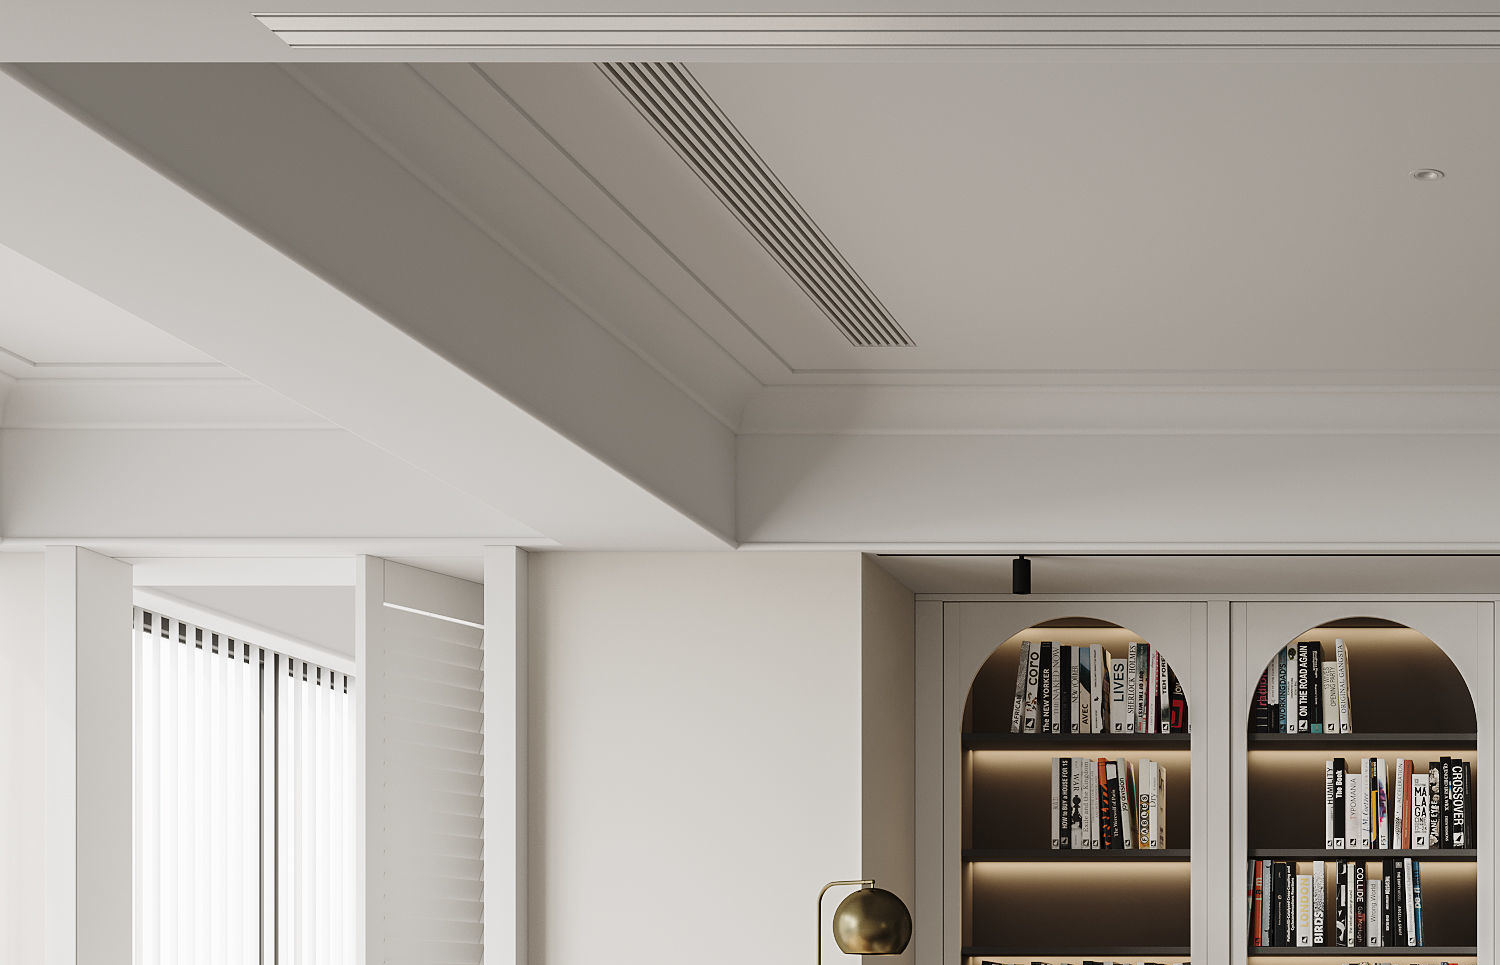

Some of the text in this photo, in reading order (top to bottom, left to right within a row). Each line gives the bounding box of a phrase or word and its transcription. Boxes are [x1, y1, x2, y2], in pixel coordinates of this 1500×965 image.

[1113, 663, 1125, 702] LIVES
[1127, 645, 1136, 714] SHERLOCK HOLMES
[1298, 645, 1308, 717] ON THE ROAD AGAIN
[1329, 684, 1337, 707] OPENING
[1339, 679, 1347, 714] ORIGINAL
[1013, 695, 1022, 724] AFRICAN
[1150, 792, 1158, 808] Dry
[1335, 769, 1343, 798] The Book
[1452, 765, 1464, 826] CROSSOVER
[1140, 794, 1149, 843] FABLES
[1415, 797, 1427, 806] LA
[1415, 807, 1427, 817] GA
[1430, 800, 1438, 835] JANE EYRE
[1299, 877, 1310, 928] LONDON
[1356, 868, 1364, 903] COLLIDE
[1313, 911, 1324, 944] BIRDS
